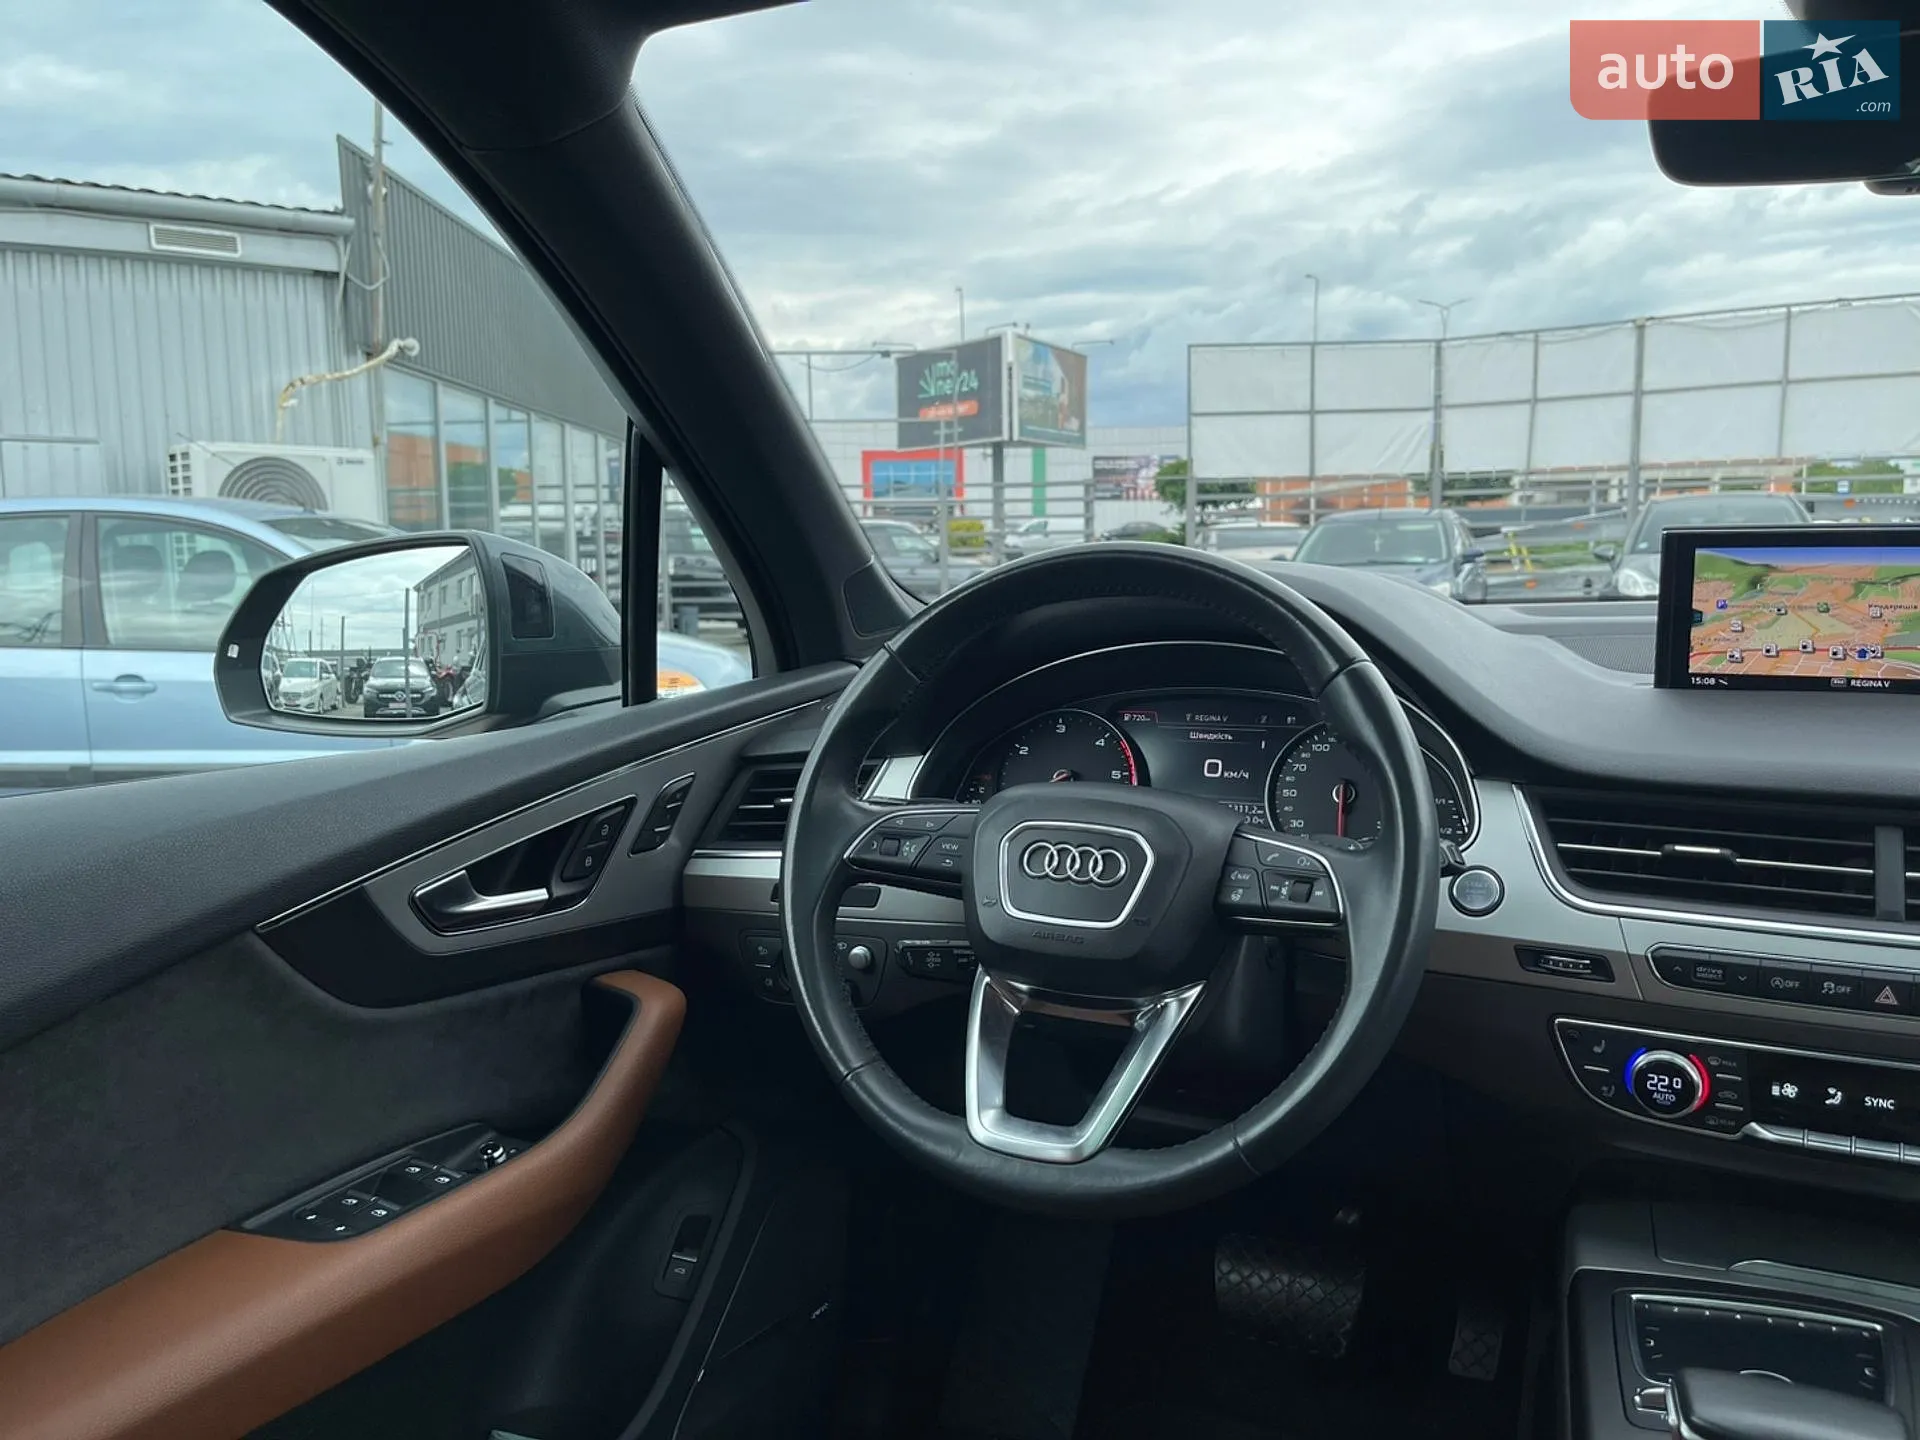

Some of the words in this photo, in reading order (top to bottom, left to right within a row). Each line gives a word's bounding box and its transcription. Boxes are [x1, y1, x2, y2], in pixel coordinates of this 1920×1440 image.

[1691, 677, 1715, 685] 15:08
[1850, 679, 1882, 687] REGINA
[1882, 680, 1890, 688] V
[1055, 724, 1066, 733] 3
[1095, 738, 1105, 747] 4
[1312, 743, 1330, 751] 100
[1019, 746, 1029, 755] 2
[1203, 759, 1222, 777] 0
[1292, 763, 1307, 771] 70
[1111, 770, 1121, 779] 5
[1282, 789, 1297, 797] 50
[1290, 819, 1304, 828] 30
[1785, 980, 1800, 988] OFF
[1836, 985, 1851, 993] OFF
[1647, 1073, 1682, 1092] 22.0
[1652, 1092, 1676, 1102] AUTO
[1864, 1095, 1895, 1110] SYNC
